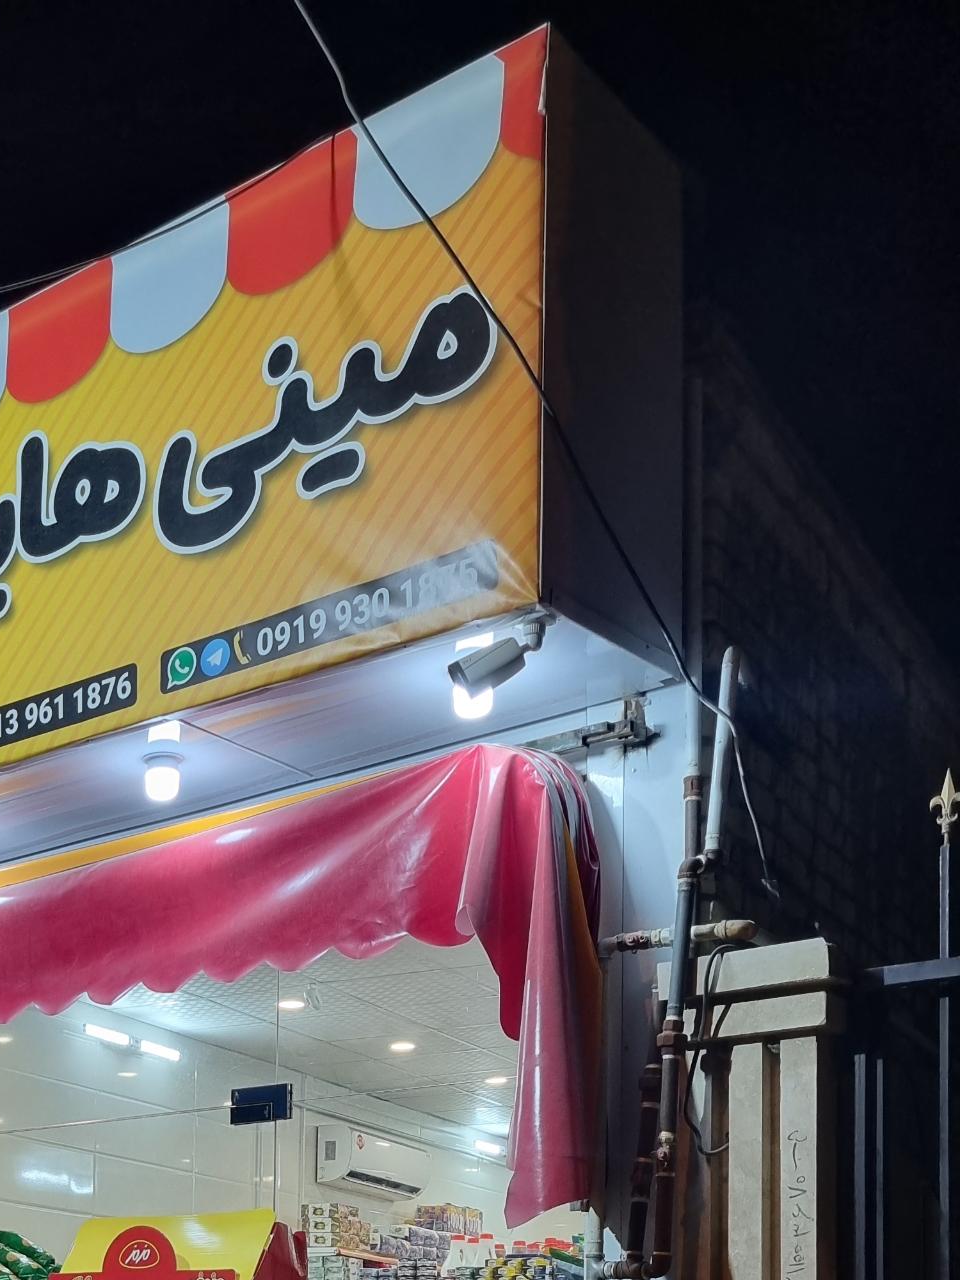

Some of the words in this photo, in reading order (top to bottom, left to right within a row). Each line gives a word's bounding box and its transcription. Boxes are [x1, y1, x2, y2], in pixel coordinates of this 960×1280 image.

[155, 286, 497, 553] مینی
[257, 609, 327, 656] 0919
[335, 588, 390, 631] 930
[25, 694, 64, 730] 961
[73, 671, 132, 714] 1876
[125, 1244, 151, 1265] مزمز
